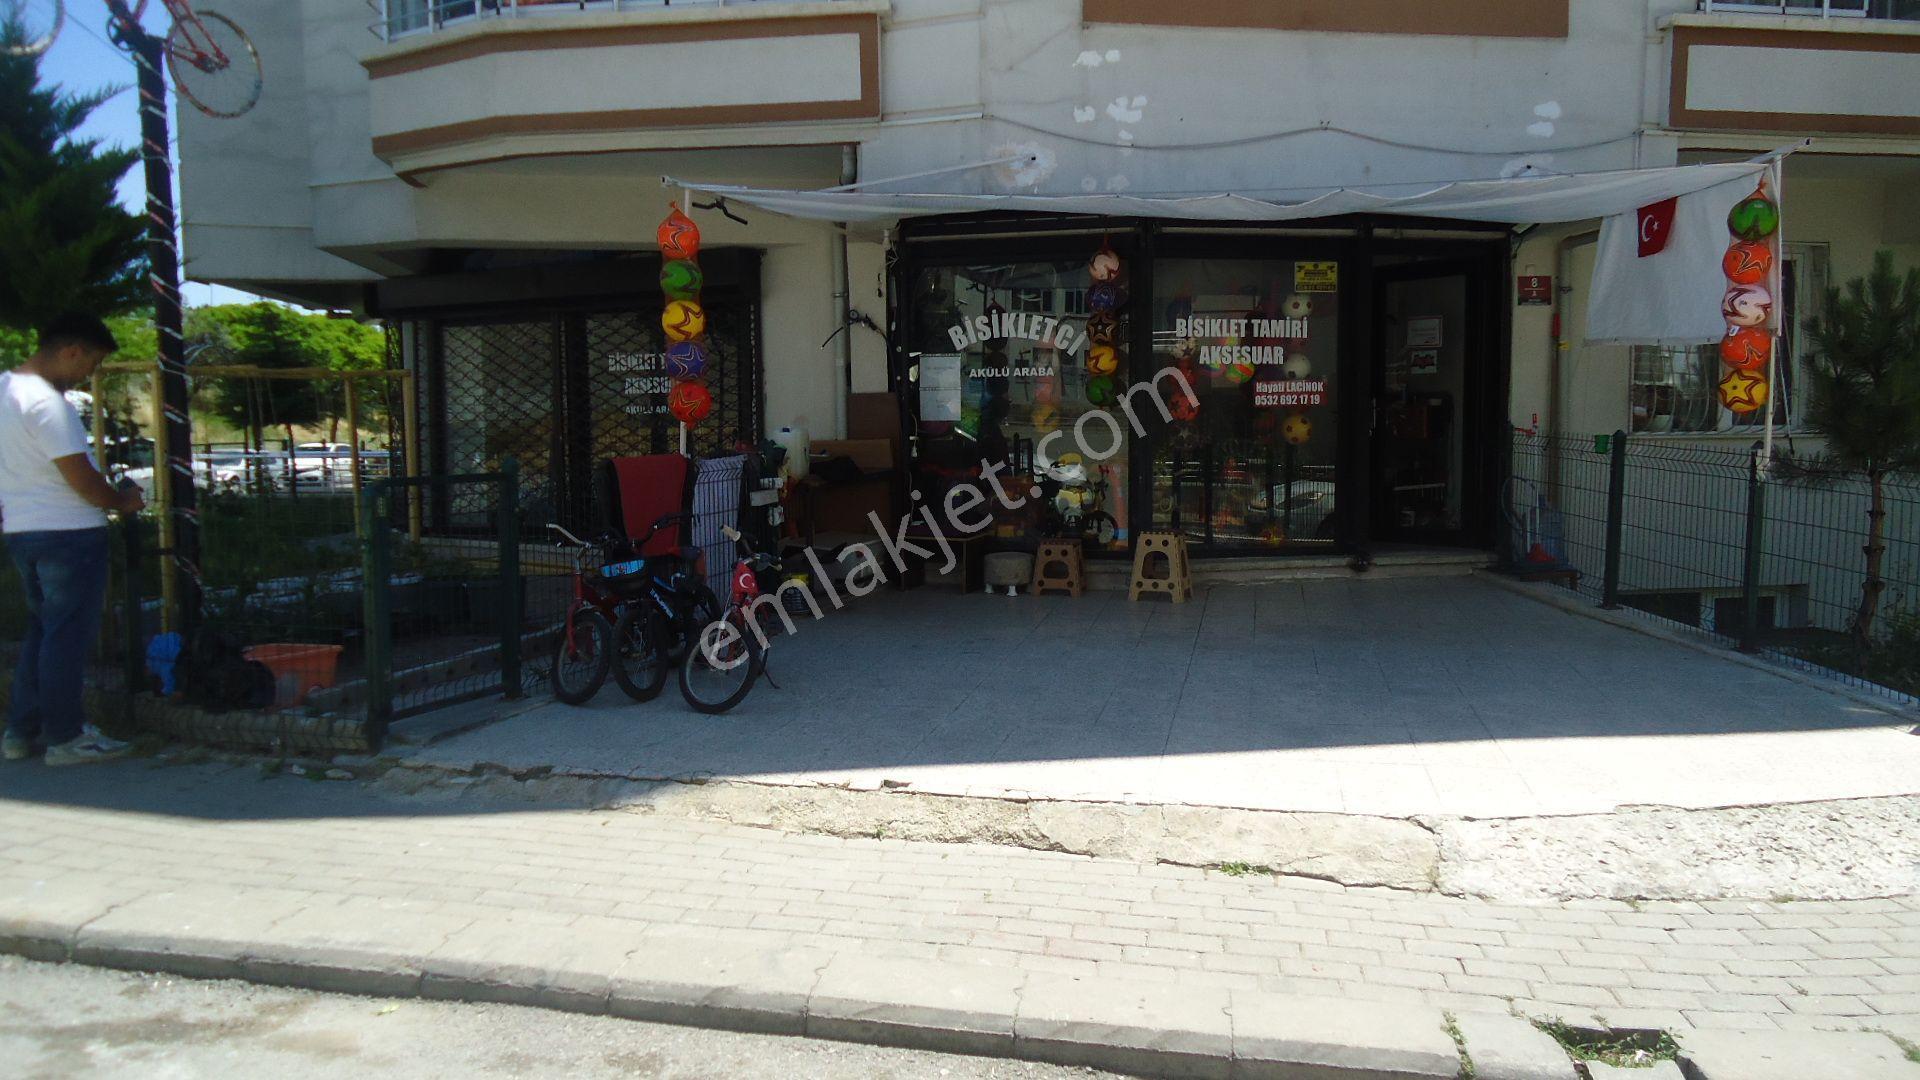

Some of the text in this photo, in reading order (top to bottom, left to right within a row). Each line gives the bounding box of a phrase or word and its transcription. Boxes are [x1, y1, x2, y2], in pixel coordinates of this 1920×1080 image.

[1531, 277, 1538, 288] 8
[948, 309, 1087, 357] BİSİKLETCİ
[1175, 315, 1309, 339] BİSİKLET TAMİRİ
[1199, 345, 1285, 365] AKSESUAR
[968, 366, 1010, 378] AKÜLÜ
[1013, 367, 1055, 377] ARABA
[1254, 394, 1321, 406] 0532 692 17 19
